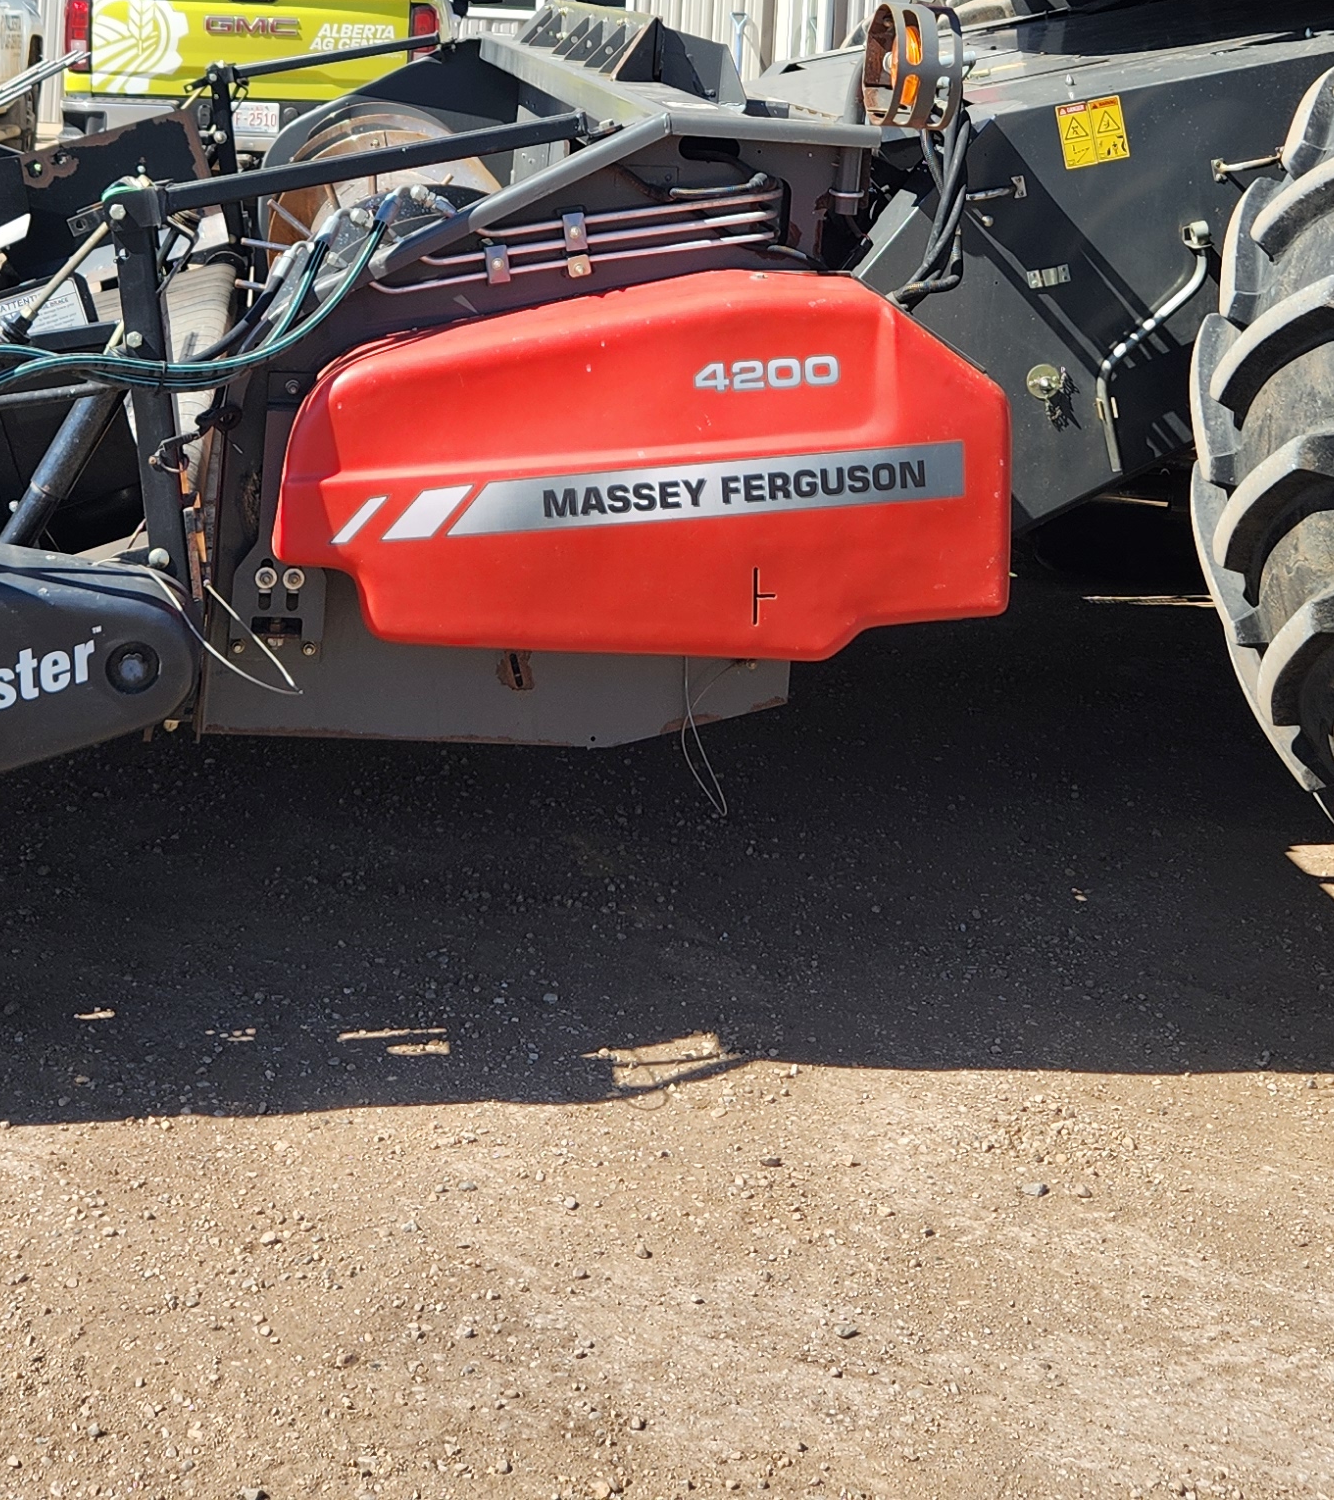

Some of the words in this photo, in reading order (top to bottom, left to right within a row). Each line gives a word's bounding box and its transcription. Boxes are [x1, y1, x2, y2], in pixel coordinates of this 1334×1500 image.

[205, 15, 299, 36] GMC
[318, 23, 395, 39] ALBERTA
[309, 37, 335, 51] AG
[338, 38, 391, 50] CEN
[0, 292, 40, 313] ATTENT
[693, 354, 840, 393] 4200
[542, 476, 707, 520] MASSEY
[720, 459, 928, 506] FERGUSON
